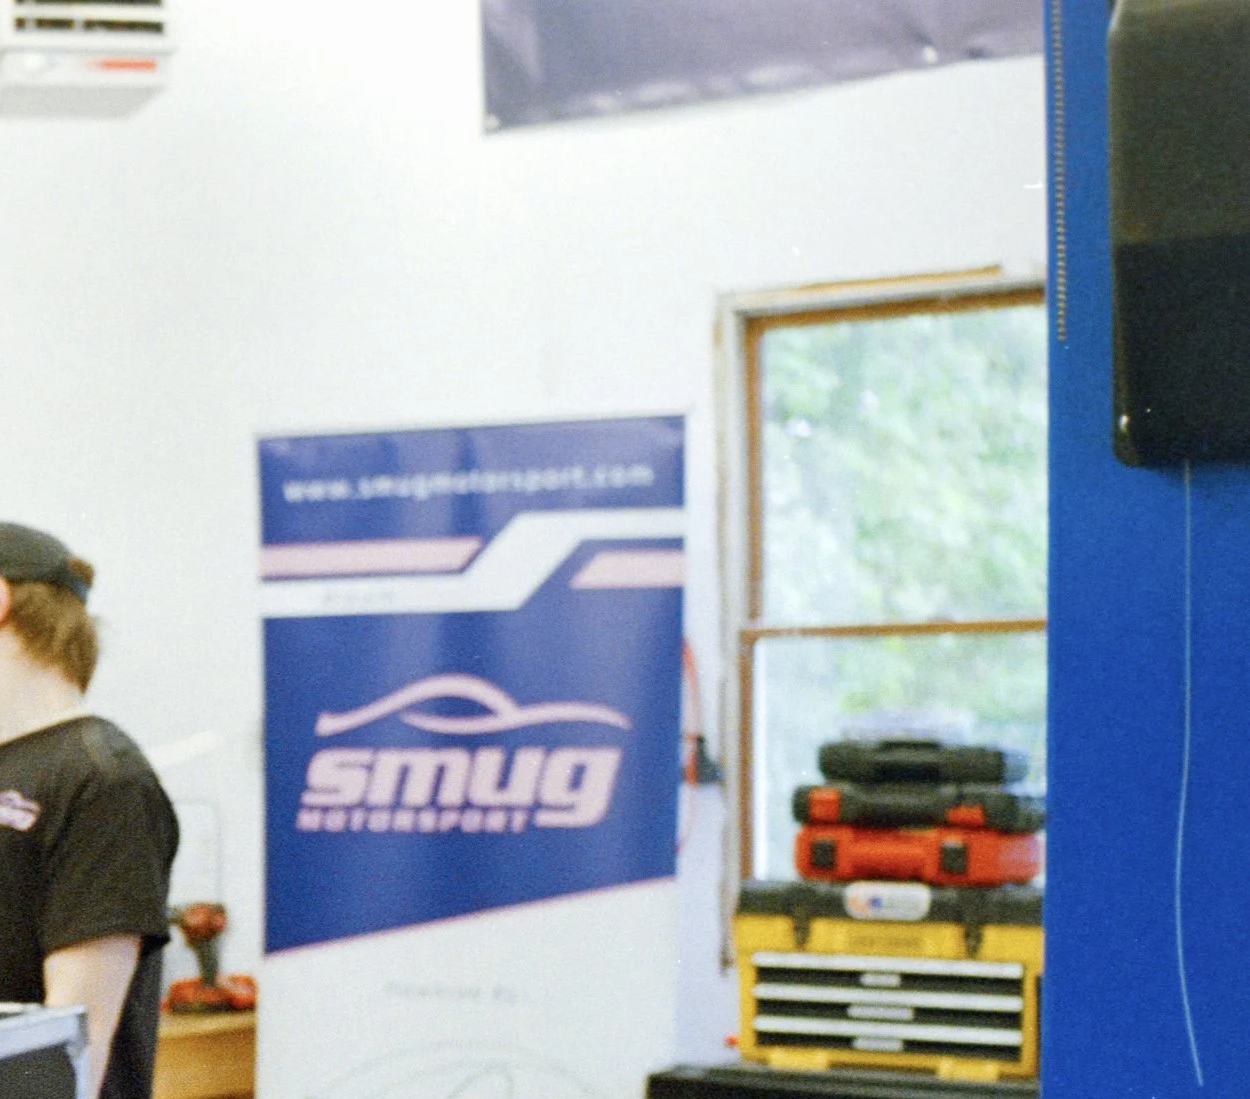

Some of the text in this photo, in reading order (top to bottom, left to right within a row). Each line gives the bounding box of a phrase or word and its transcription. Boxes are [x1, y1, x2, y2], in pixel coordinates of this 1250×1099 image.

[283, 464, 653, 501] www.smugmotorsport.com
[303, 748, 623, 829] smug
[296, 805, 529, 834] MOTORSPORT
